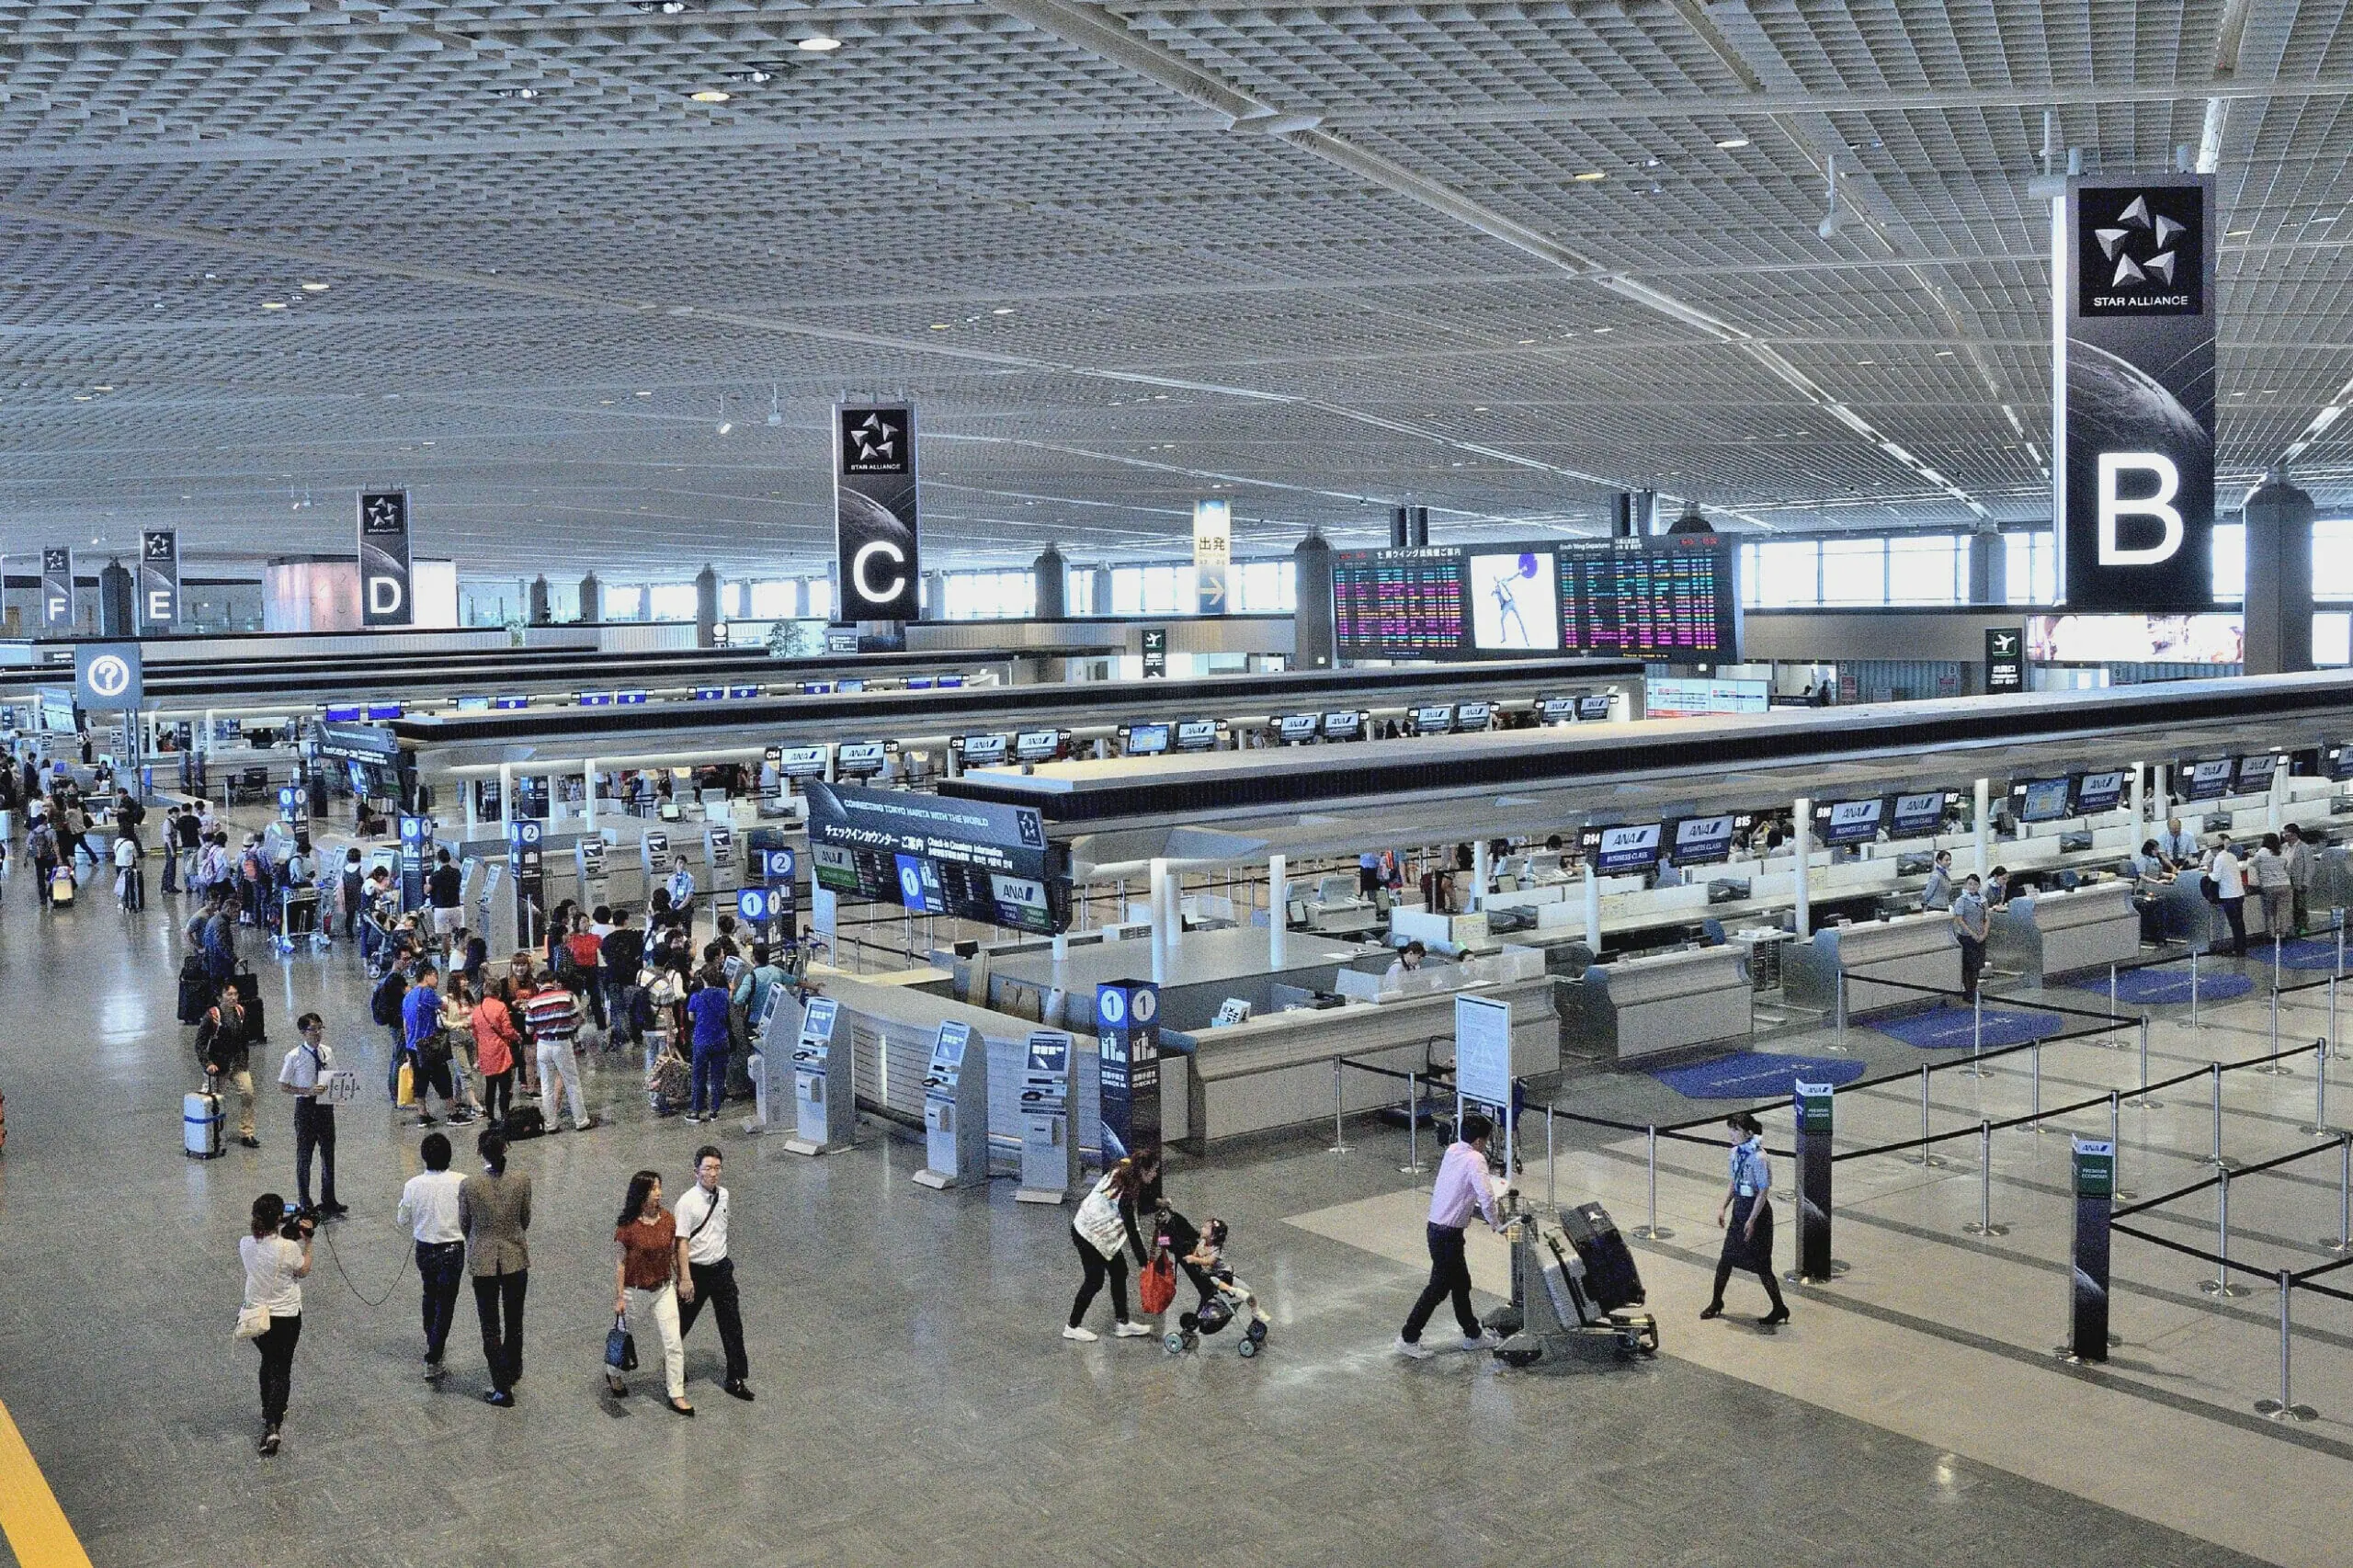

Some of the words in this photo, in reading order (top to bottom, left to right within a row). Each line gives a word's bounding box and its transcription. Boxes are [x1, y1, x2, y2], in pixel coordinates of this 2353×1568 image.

[2094, 295, 2125, 307] STAR
[2129, 294, 2188, 306] ALLIANCE
[2097, 451, 2184, 566] B
[1199, 537, 1225, 551] 出発
[853, 540, 906, 604] C
[369, 576, 402, 614] D
[49, 597, 67, 621] F
[149, 591, 172, 619] E
[790, 753, 809, 761] ANA
[848, 748, 867, 757] ANA
[1905, 800, 1925, 811] ANA
[844, 799, 883, 812] CONNECTING
[883, 805, 906, 815] TOKYO
[906, 807, 930, 819] NARITA
[929, 811, 949, 821] WITH
[948, 813, 963, 824] THE
[962, 815, 989, 826] WORLD
[1841, 807, 1861, 819] ANA
[1734, 816, 1751, 827] B15
[527, 827, 534, 839] 2
[825, 824, 900, 846] チェックインカウンター
[1688, 824, 1711, 837] ANA
[1583, 833, 1600, 846] B14
[1612, 834, 1636, 846] ANA
[1682, 846, 1705, 854] BUSINESS
[1705, 843, 1722, 851] CLASS
[777, 857, 786, 869] 2
[822, 849, 837, 864] ANA
[1606, 854, 1631, 863] BUSINESS
[1631, 851, 1648, 859] CLASS
[906, 873, 914, 891] 1
[1003, 884, 1025, 901] ANA
[746, 896, 755, 913] 1
[771, 895, 777, 911] 1
[1108, 995, 1115, 1017] 1
[1140, 995, 1146, 1016] 1
[1101, 1078, 1120, 1087] CHECK
[1131, 1079, 1151, 1088] CHECK
